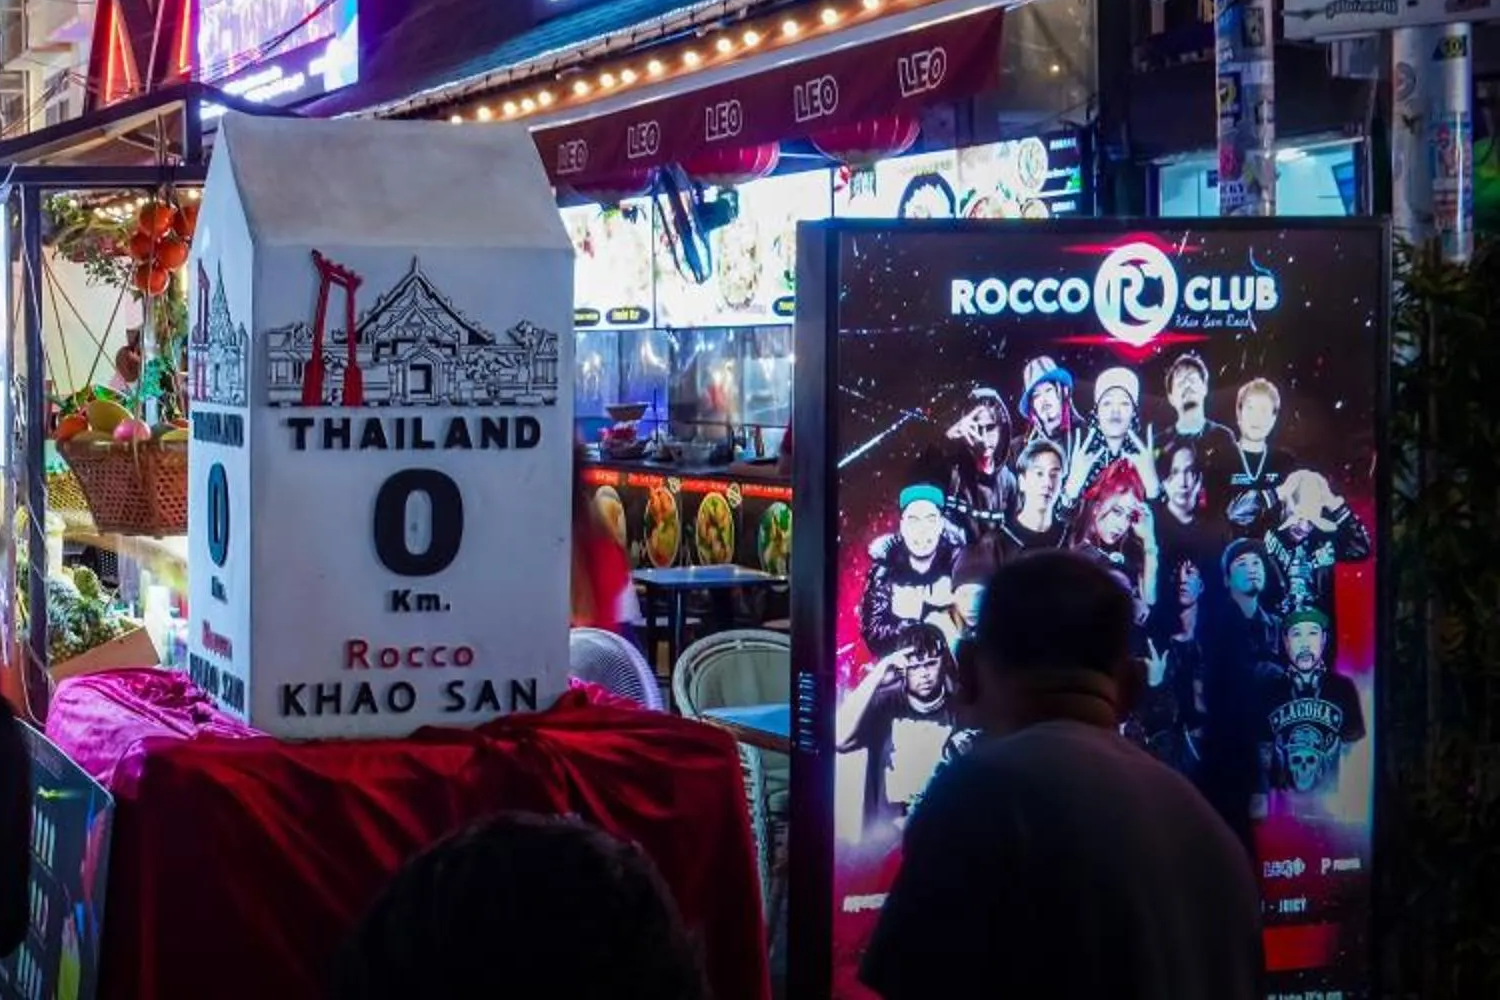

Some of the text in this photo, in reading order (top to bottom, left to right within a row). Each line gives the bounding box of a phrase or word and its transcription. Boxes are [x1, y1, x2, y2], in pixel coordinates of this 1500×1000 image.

[899, 47, 946, 98] LEO
[794, 75, 838, 122] LEO
[627, 121, 660, 158] LEO
[705, 100, 743, 141] LEO
[557, 139, 589, 175] LEO
[950, 277, 1091, 315] ROCCO
[1183, 275, 1279, 312] CLUB
[287, 415, 542, 451] THAILAND
[207, 462, 230, 568] 0
[373, 468, 464, 577] 0
[388, 589, 452, 613] Km.
[344, 639, 475, 669] Rocco
[281, 678, 538, 716] KHAO SAN
